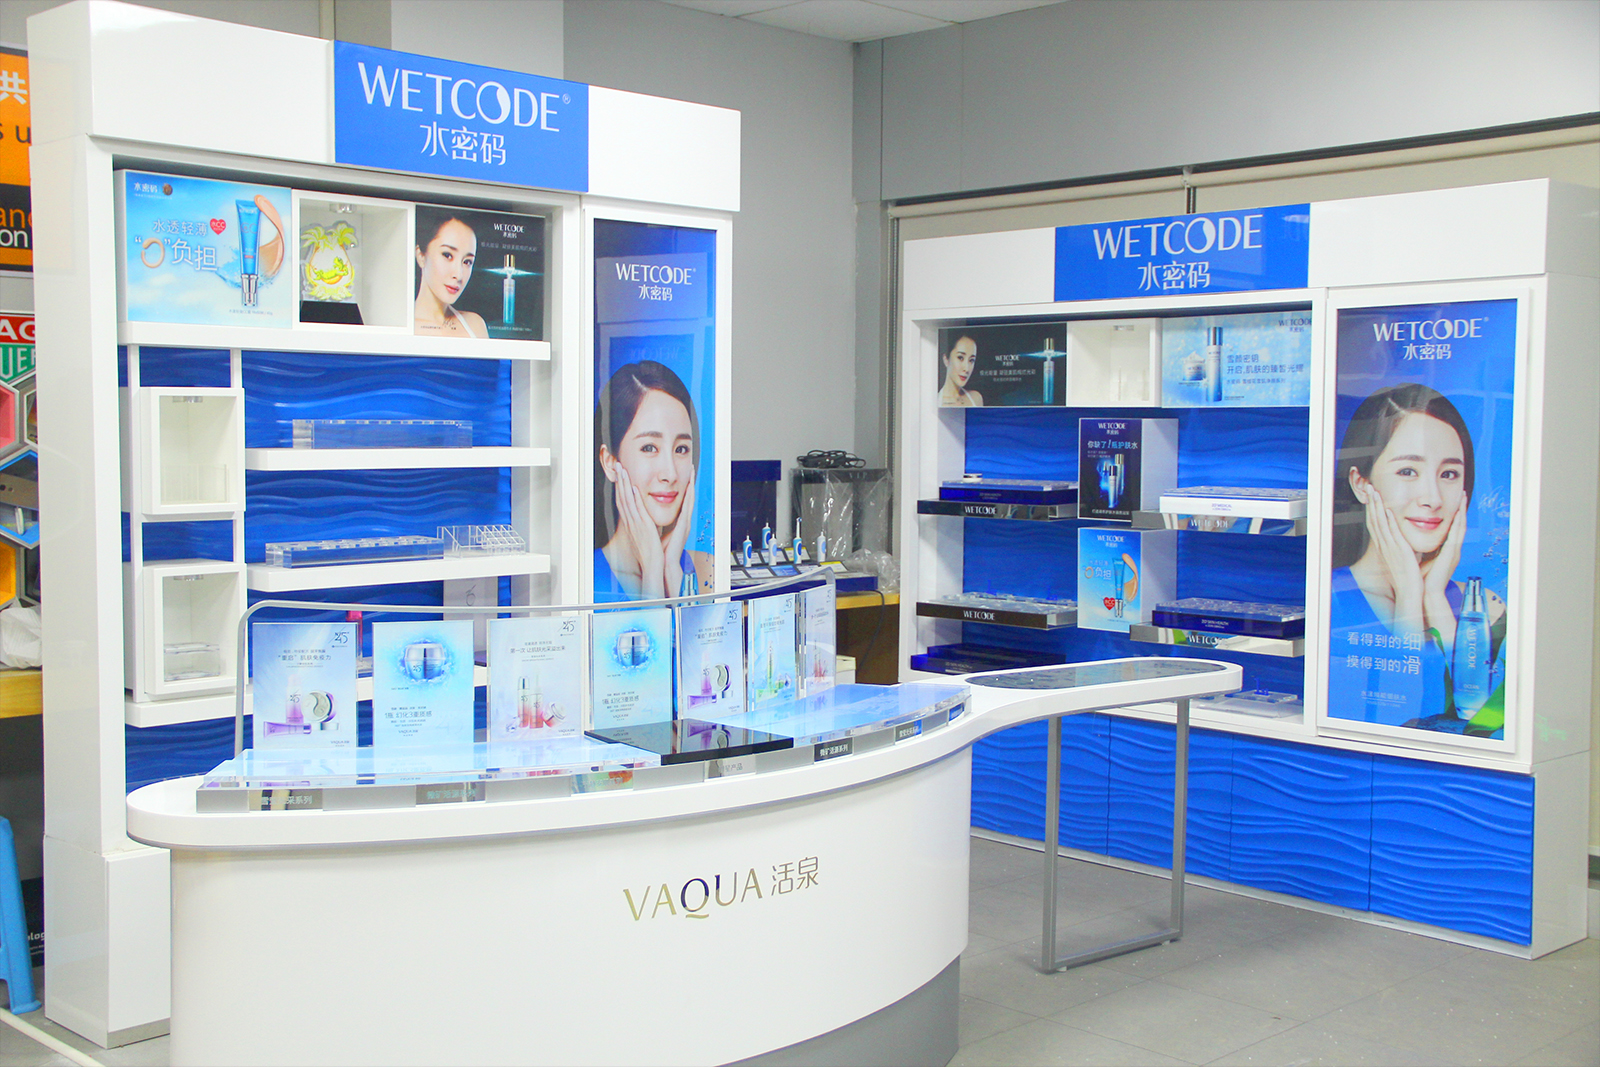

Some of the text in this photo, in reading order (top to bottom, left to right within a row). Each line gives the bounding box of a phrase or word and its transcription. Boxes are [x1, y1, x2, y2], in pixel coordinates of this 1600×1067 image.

[420, 121, 507, 166] 水密码
[152, 219, 207, 236] 水透轻薄
[493, 223, 525, 233] WETCODE
[1093, 214, 1263, 260] WETCODE
[615, 262, 692, 285] WETCODE
[1138, 260, 1210, 291] 水密码
[638, 284, 673, 301] 水密码
[1373, 318, 1482, 341] WETCODE
[1403, 343, 1451, 361] 水密码
[964, 505, 996, 515] WETCODE
[1347, 631, 1422, 651] 看得到的细
[1346, 655, 1421, 675] 摸得到的滑
[623, 856, 819, 921] VAQUA 活泉
